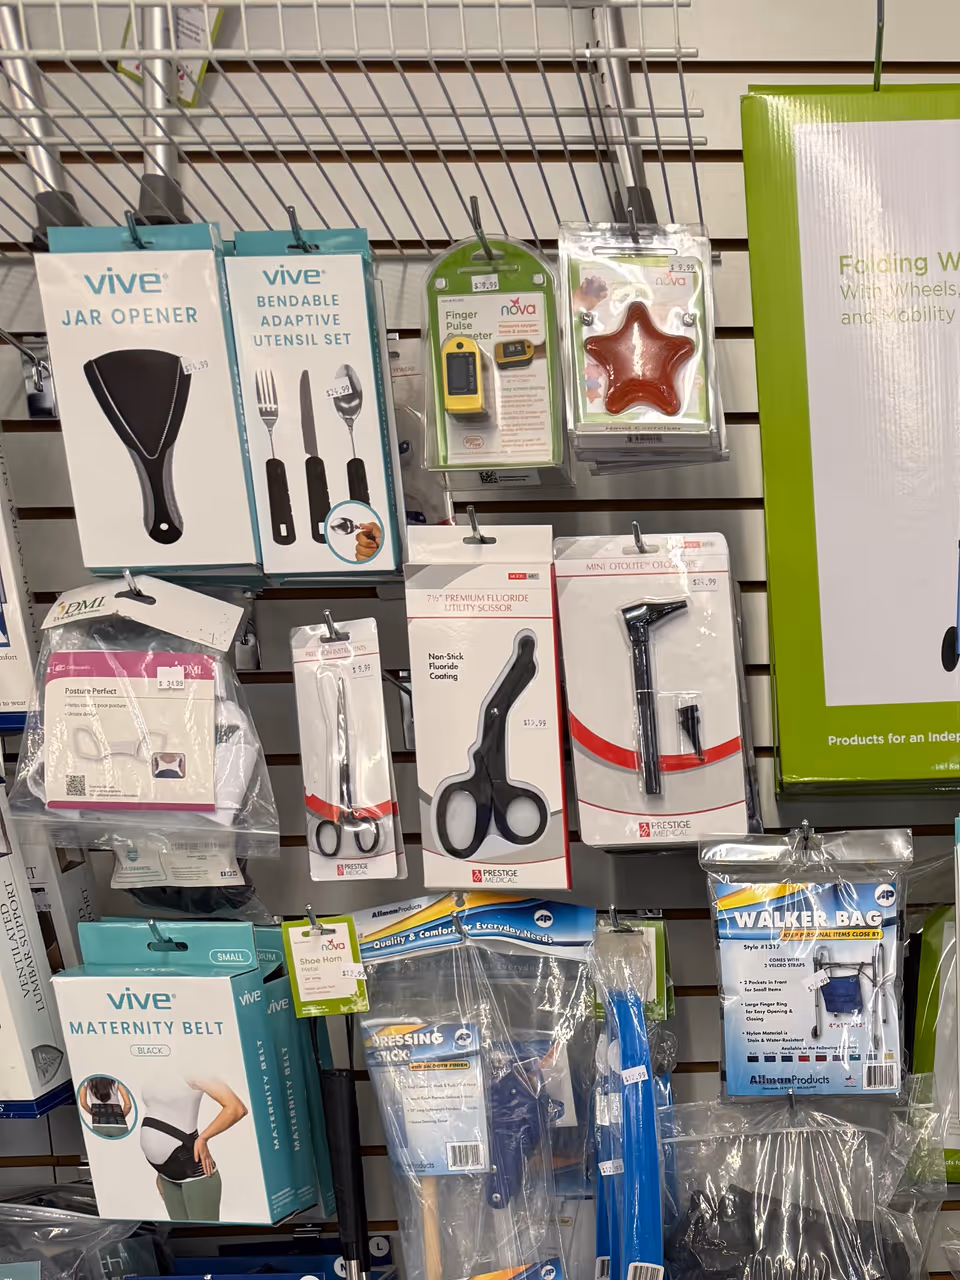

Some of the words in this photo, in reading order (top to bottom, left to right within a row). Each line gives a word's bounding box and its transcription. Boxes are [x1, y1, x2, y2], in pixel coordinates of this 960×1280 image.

[838, 253, 928, 277] Folding
[84, 267, 162, 294] vive
[262, 265, 321, 285] vive
[840, 281, 882, 300] With
[257, 295, 339, 308] BENDABLE
[62, 310, 101, 326] JAR
[112, 307, 198, 325] OPENER
[446, 311, 478, 319] Finger
[501, 304, 536, 316] nova
[841, 307, 873, 325] and
[882, 305, 956, 325] Mobility
[260, 314, 340, 327] ADAPTIVE
[446, 321, 472, 330] Pulse
[254, 334, 318, 347] UTENSIL
[324, 333, 351, 344] SET
[445, 594, 484, 602] PREMIUM
[487, 594, 528, 602] FLUORIDE
[445, 604, 474, 612] UTILITY
[478, 603, 512, 612] SCISSOR
[428, 653, 464, 661] Non-Stick
[429, 673, 458, 681] Coating
[65, 687, 89, 695] Posture
[92, 686, 117, 695] Perfect
[827, 732, 883, 747] Products
[887, 732, 906, 745] for
[910, 734, 924, 744] an
[483, 870, 518, 878] PRESTIGE
[734, 912, 828, 928] WALKER
[836, 911, 882, 927] BAG
[374, 936, 406, 949] Quality
[409, 931, 415, 940] &
[418, 925, 457, 938] Comfort
[476, 922, 520, 936] Everyday
[523, 930, 553, 944] Needs
[1, 902, 30, 999] VENTILATED
[217, 952, 244, 961] SMALL
[300, 957, 320, 966] Shoe
[322, 955, 342, 963] Horn
[107, 987, 172, 1010] vive
[69, 1022, 174, 1035] MATERNITY
[183, 1022, 224, 1034] BELT
[256, 1040, 268, 1070] BELT
[624, 1070, 646, 1083] $12.99
[750, 1075, 830, 1085] AllmanProducts
[262, 1073, 279, 1150] MATERNITY
